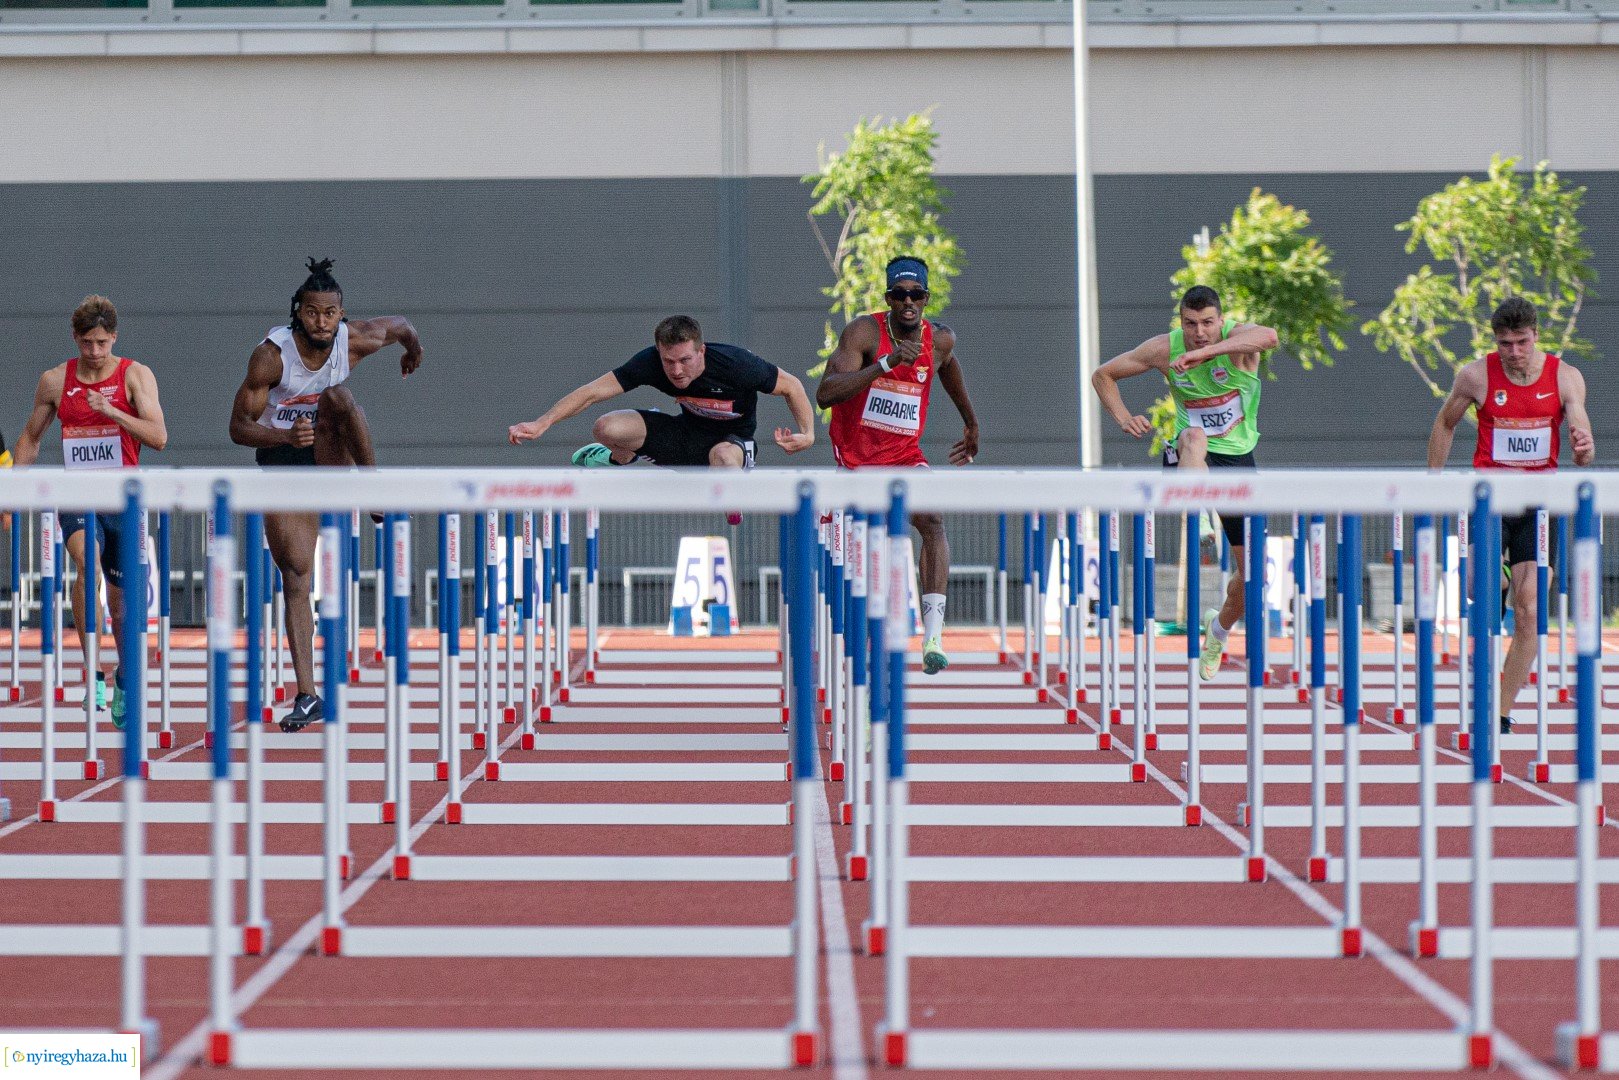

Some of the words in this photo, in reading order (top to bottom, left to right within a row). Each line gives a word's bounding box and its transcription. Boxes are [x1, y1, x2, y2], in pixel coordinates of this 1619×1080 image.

[868, 396, 918, 421] IRIBARNE
[1200, 408, 1234, 429] ESZES
[72, 442, 114, 462] POLYÁK
[1508, 437, 1539, 453] NAGY
[139, 521, 147, 550] polanik
[834, 523, 842, 552] polanik
[1539, 523, 1547, 553] polanik
[396, 541, 405, 577] polanik
[855, 541, 863, 577] polanik
[1314, 543, 1322, 579] polanik
[682, 557, 701, 608] 5
[714, 557, 727, 606] 5
